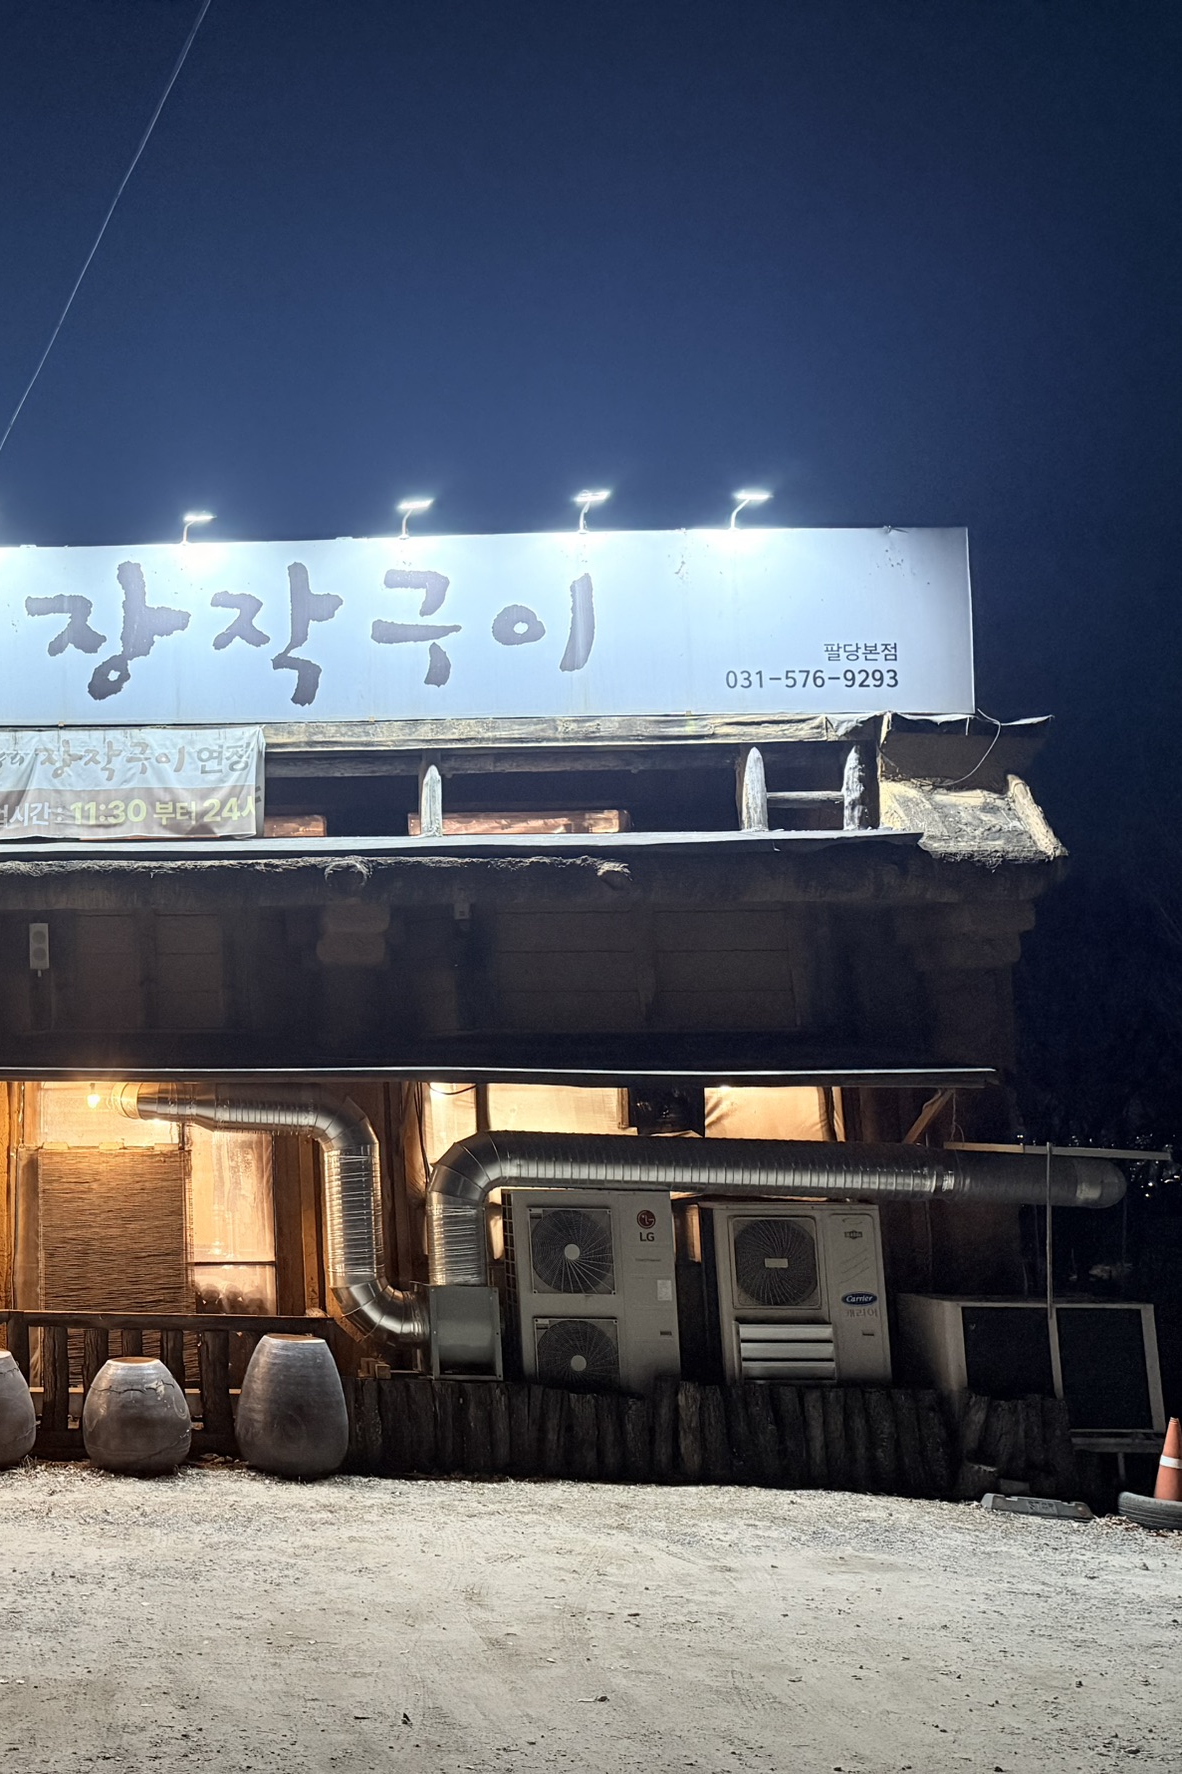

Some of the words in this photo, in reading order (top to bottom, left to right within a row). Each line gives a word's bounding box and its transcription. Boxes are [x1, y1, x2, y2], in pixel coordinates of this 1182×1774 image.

[25, 560, 594, 707] 장작구이
[823, 642, 899, 662] 팔당본점
[725, 669, 899, 689] 031-576-9293
[35, 739, 186, 782] 장작구이
[70, 799, 147, 826] 11:30
[153, 801, 196, 825] 부터
[639, 1231, 655, 1242] LG
[845, 1294, 874, 1303] Carrier
